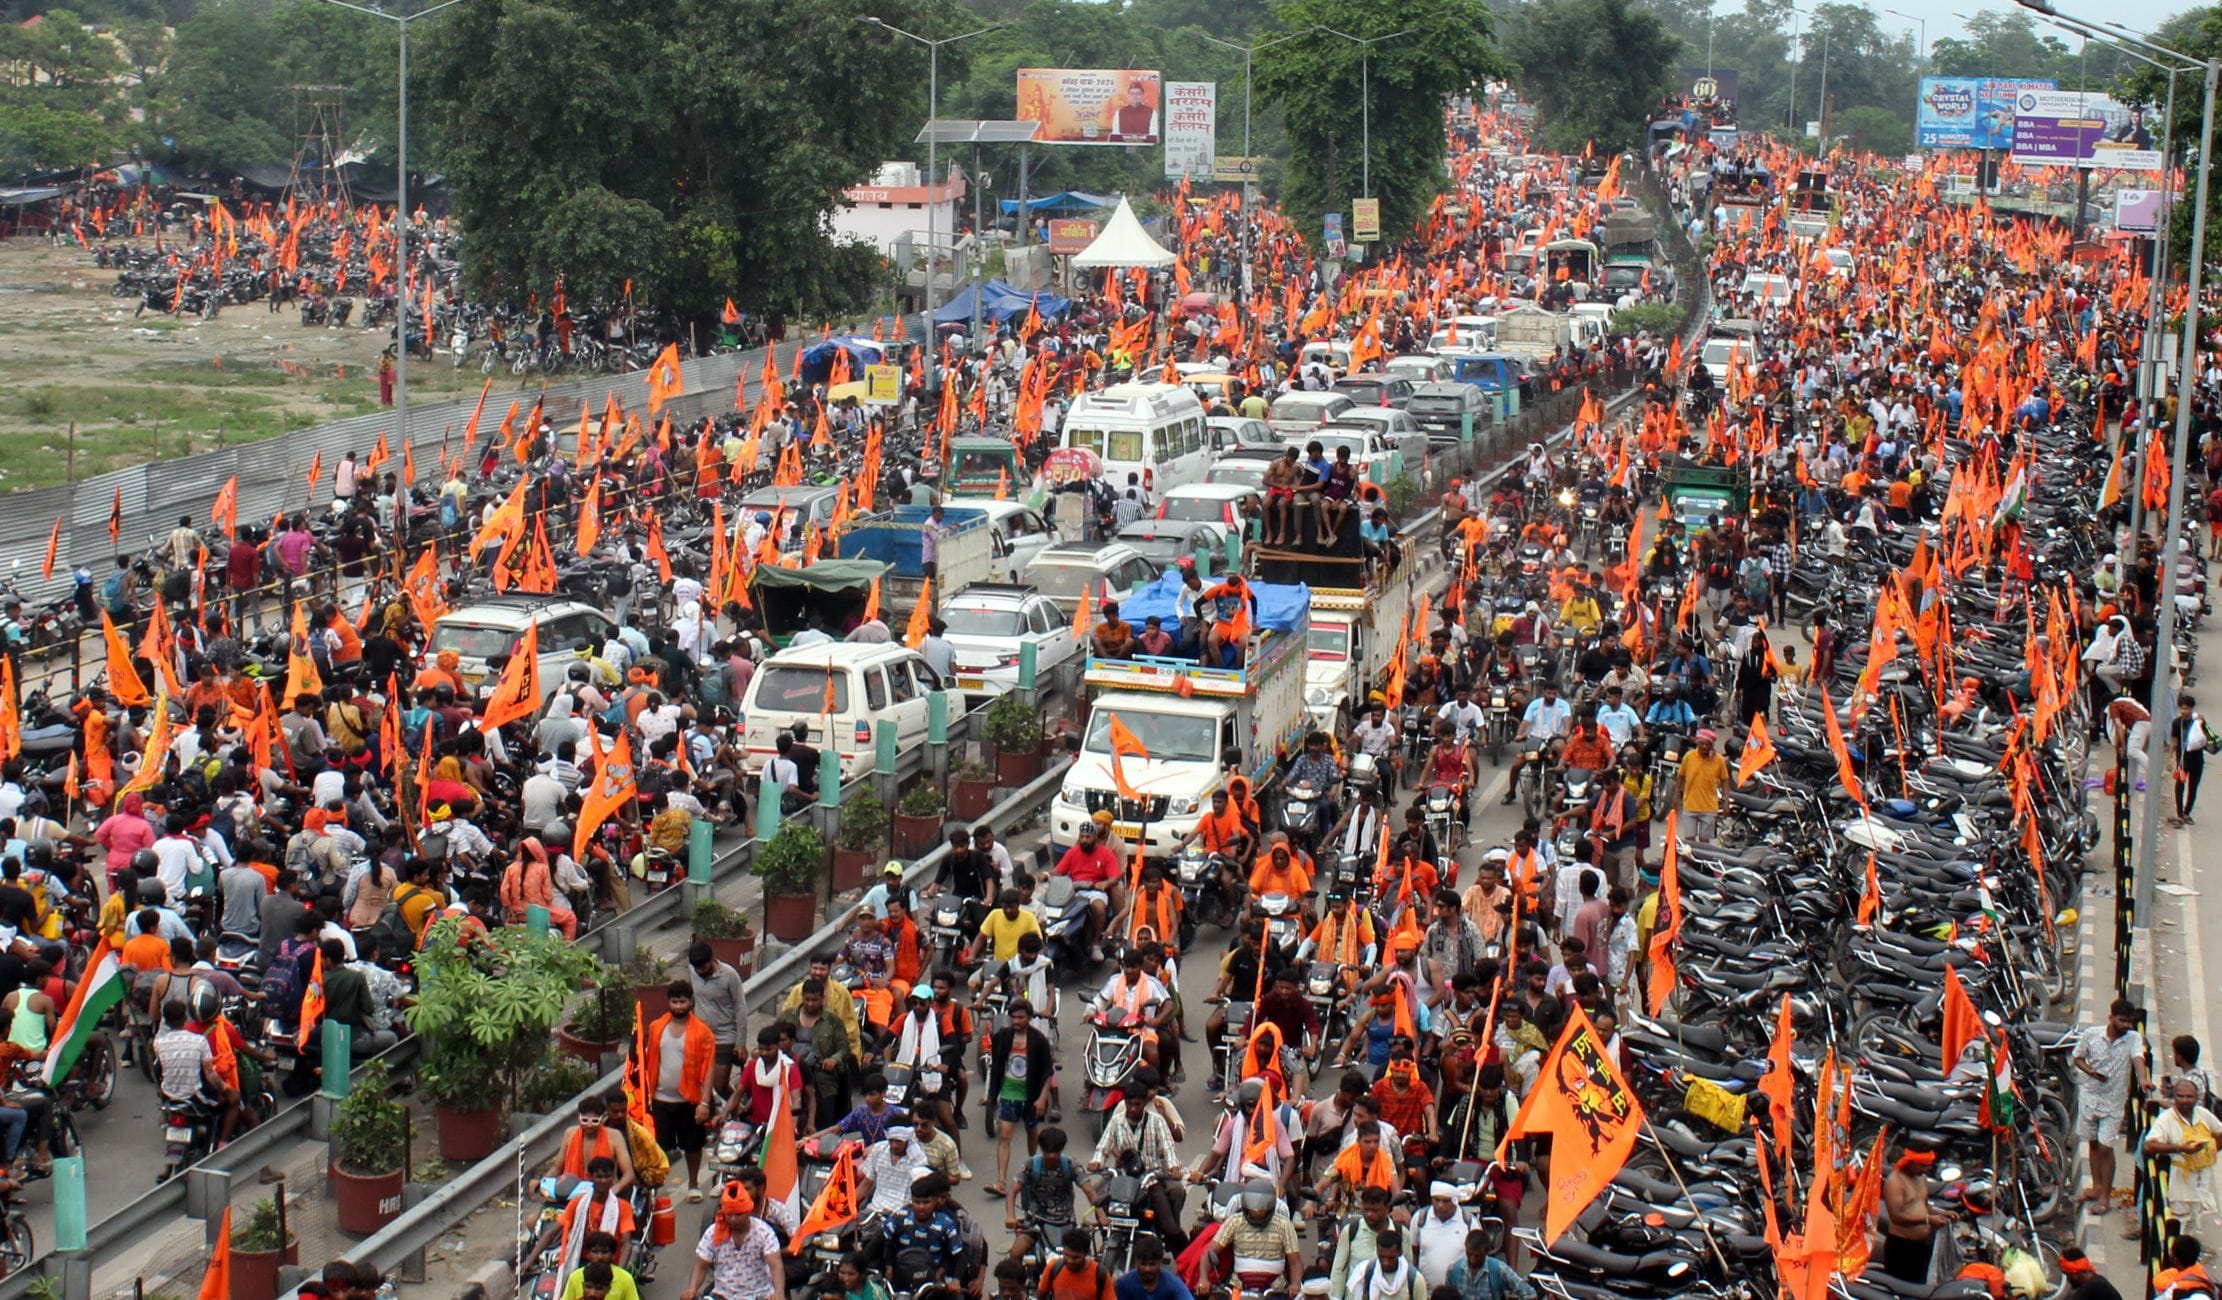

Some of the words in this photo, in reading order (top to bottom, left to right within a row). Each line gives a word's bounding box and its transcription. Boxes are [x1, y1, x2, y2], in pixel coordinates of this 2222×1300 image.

[1174, 85, 1206, 97] केसरी
[1168, 97, 1213, 107] मरहम
[1932, 93, 1970, 102] CRYSTAL
[1936, 102, 1968, 110] WORLD
[1174, 109, 1206, 121] केसरी
[2017, 120, 2035, 128] BBA
[1922, 133, 1937, 144] 25
[2016, 131, 2034, 139] BBA
[2015, 142, 2033, 151] BBA
[2038, 143, 2057, 152] MBA
